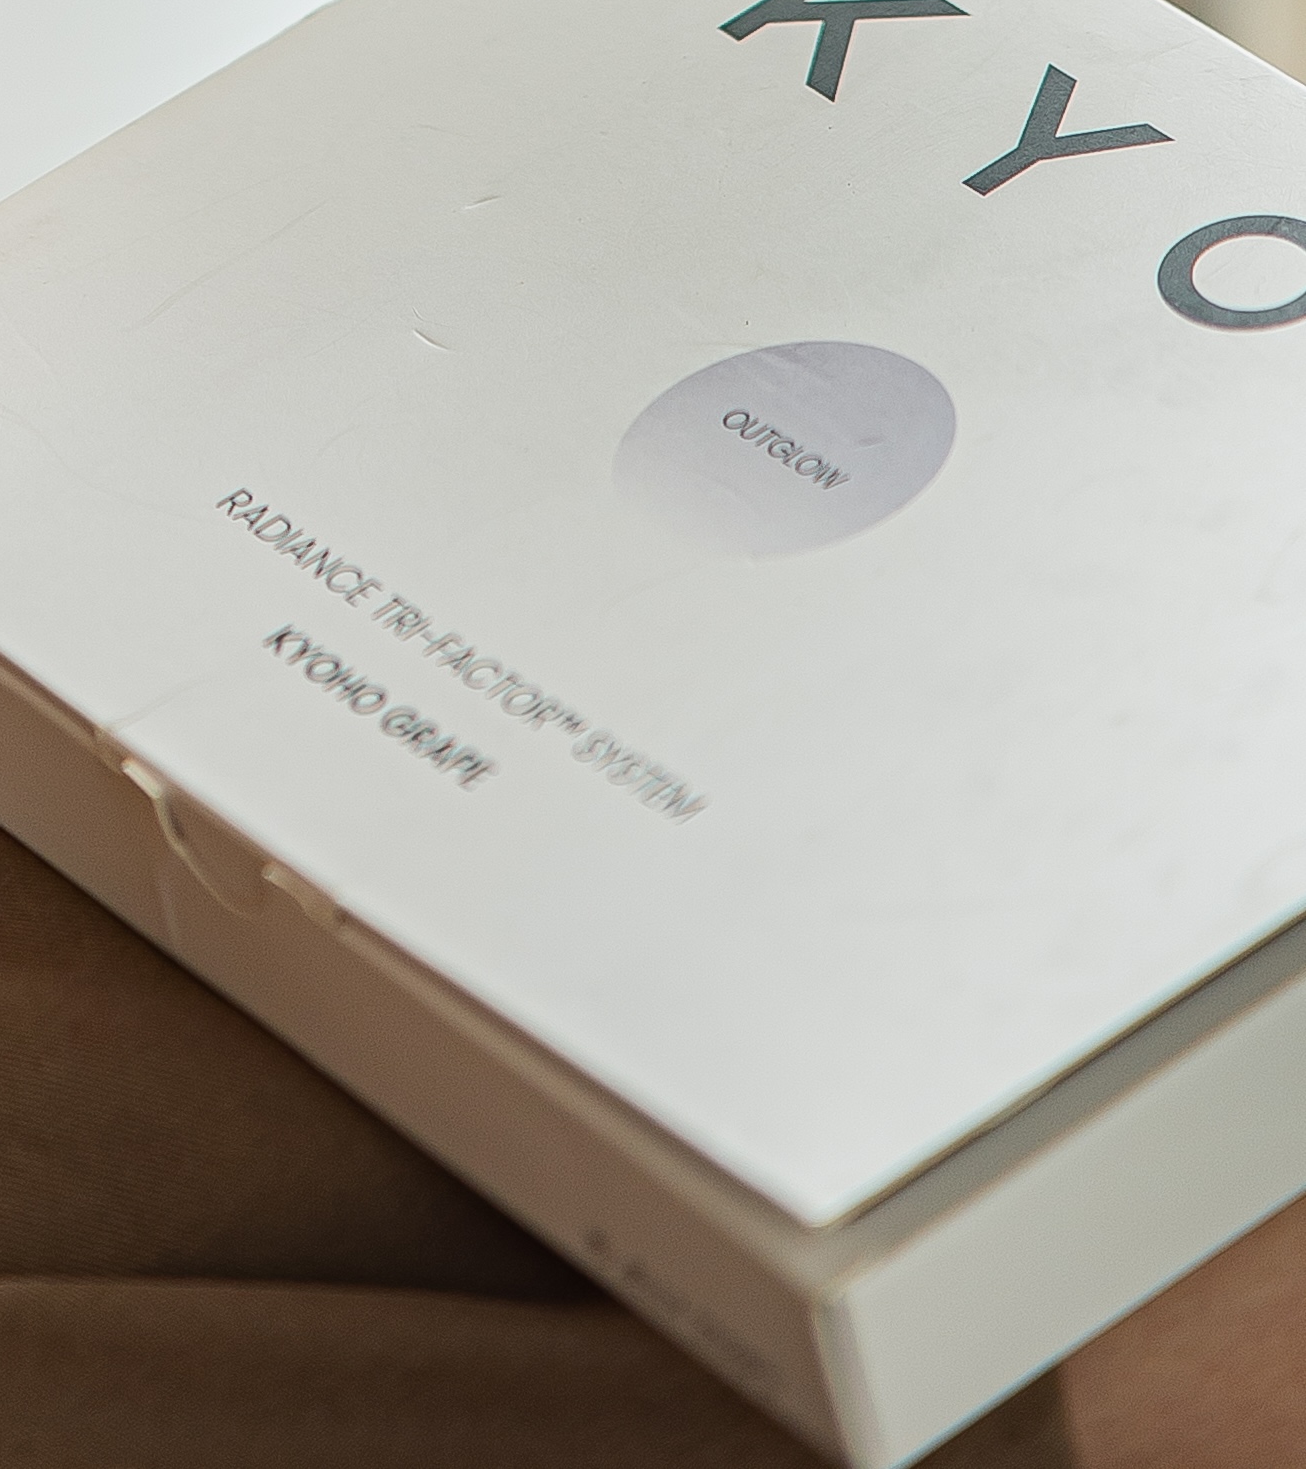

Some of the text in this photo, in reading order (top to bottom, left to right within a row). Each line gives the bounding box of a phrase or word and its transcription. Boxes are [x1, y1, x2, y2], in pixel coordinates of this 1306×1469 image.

[723, 411, 848, 489] OUTGLOW
[217, 488, 380, 606] RADIANCE
[571, 728, 708, 825] SYSTEM
[264, 624, 498, 790] KYOHO GRAPE
